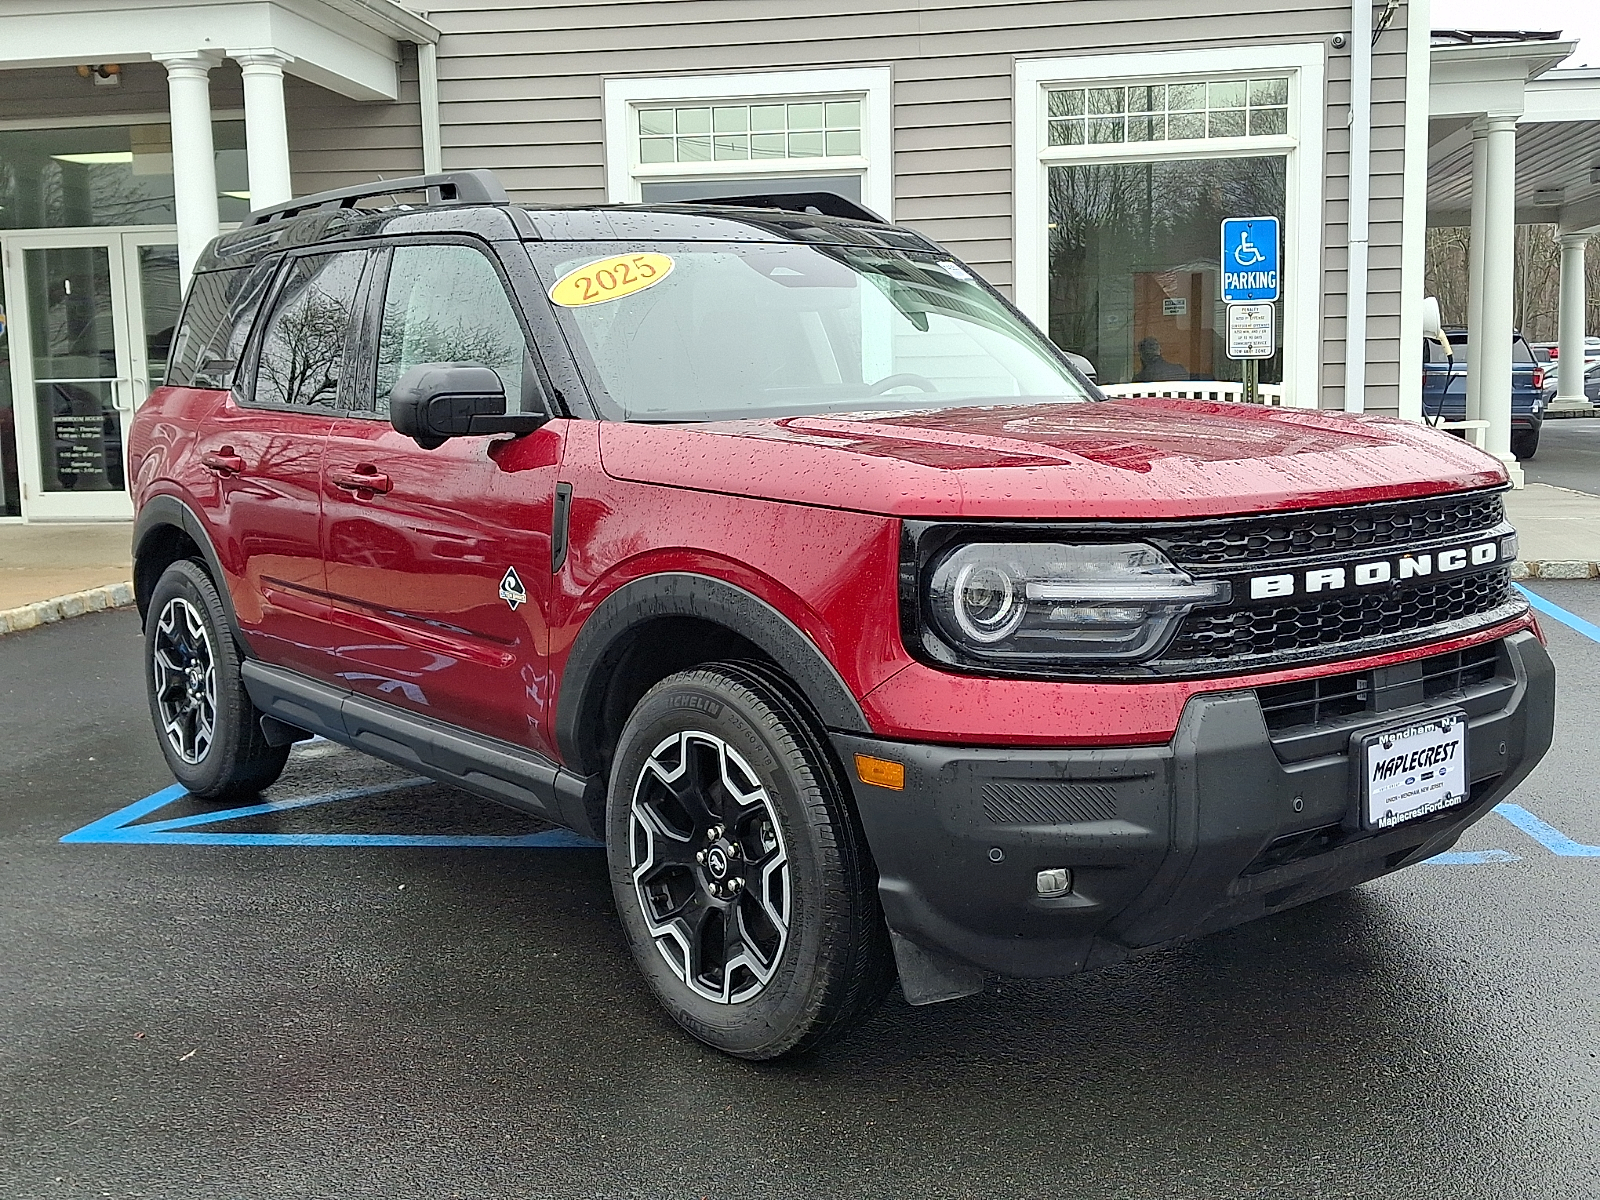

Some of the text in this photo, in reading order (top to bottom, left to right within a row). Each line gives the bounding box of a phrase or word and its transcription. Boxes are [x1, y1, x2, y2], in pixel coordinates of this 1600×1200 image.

[574, 256, 656, 301] 2025
[1224, 271, 1276, 289] PARKING
[1251, 542, 1498, 600] BRONCO
[665, 695, 719, 714] ICHELIN
[728, 714, 756, 744] 225/60
[1378, 716, 1457, 745] Mendham, NJ
[1372, 740, 1460, 782] MAPLECREST
[1378, 796, 1462, 828] MaplecrestFord.com
